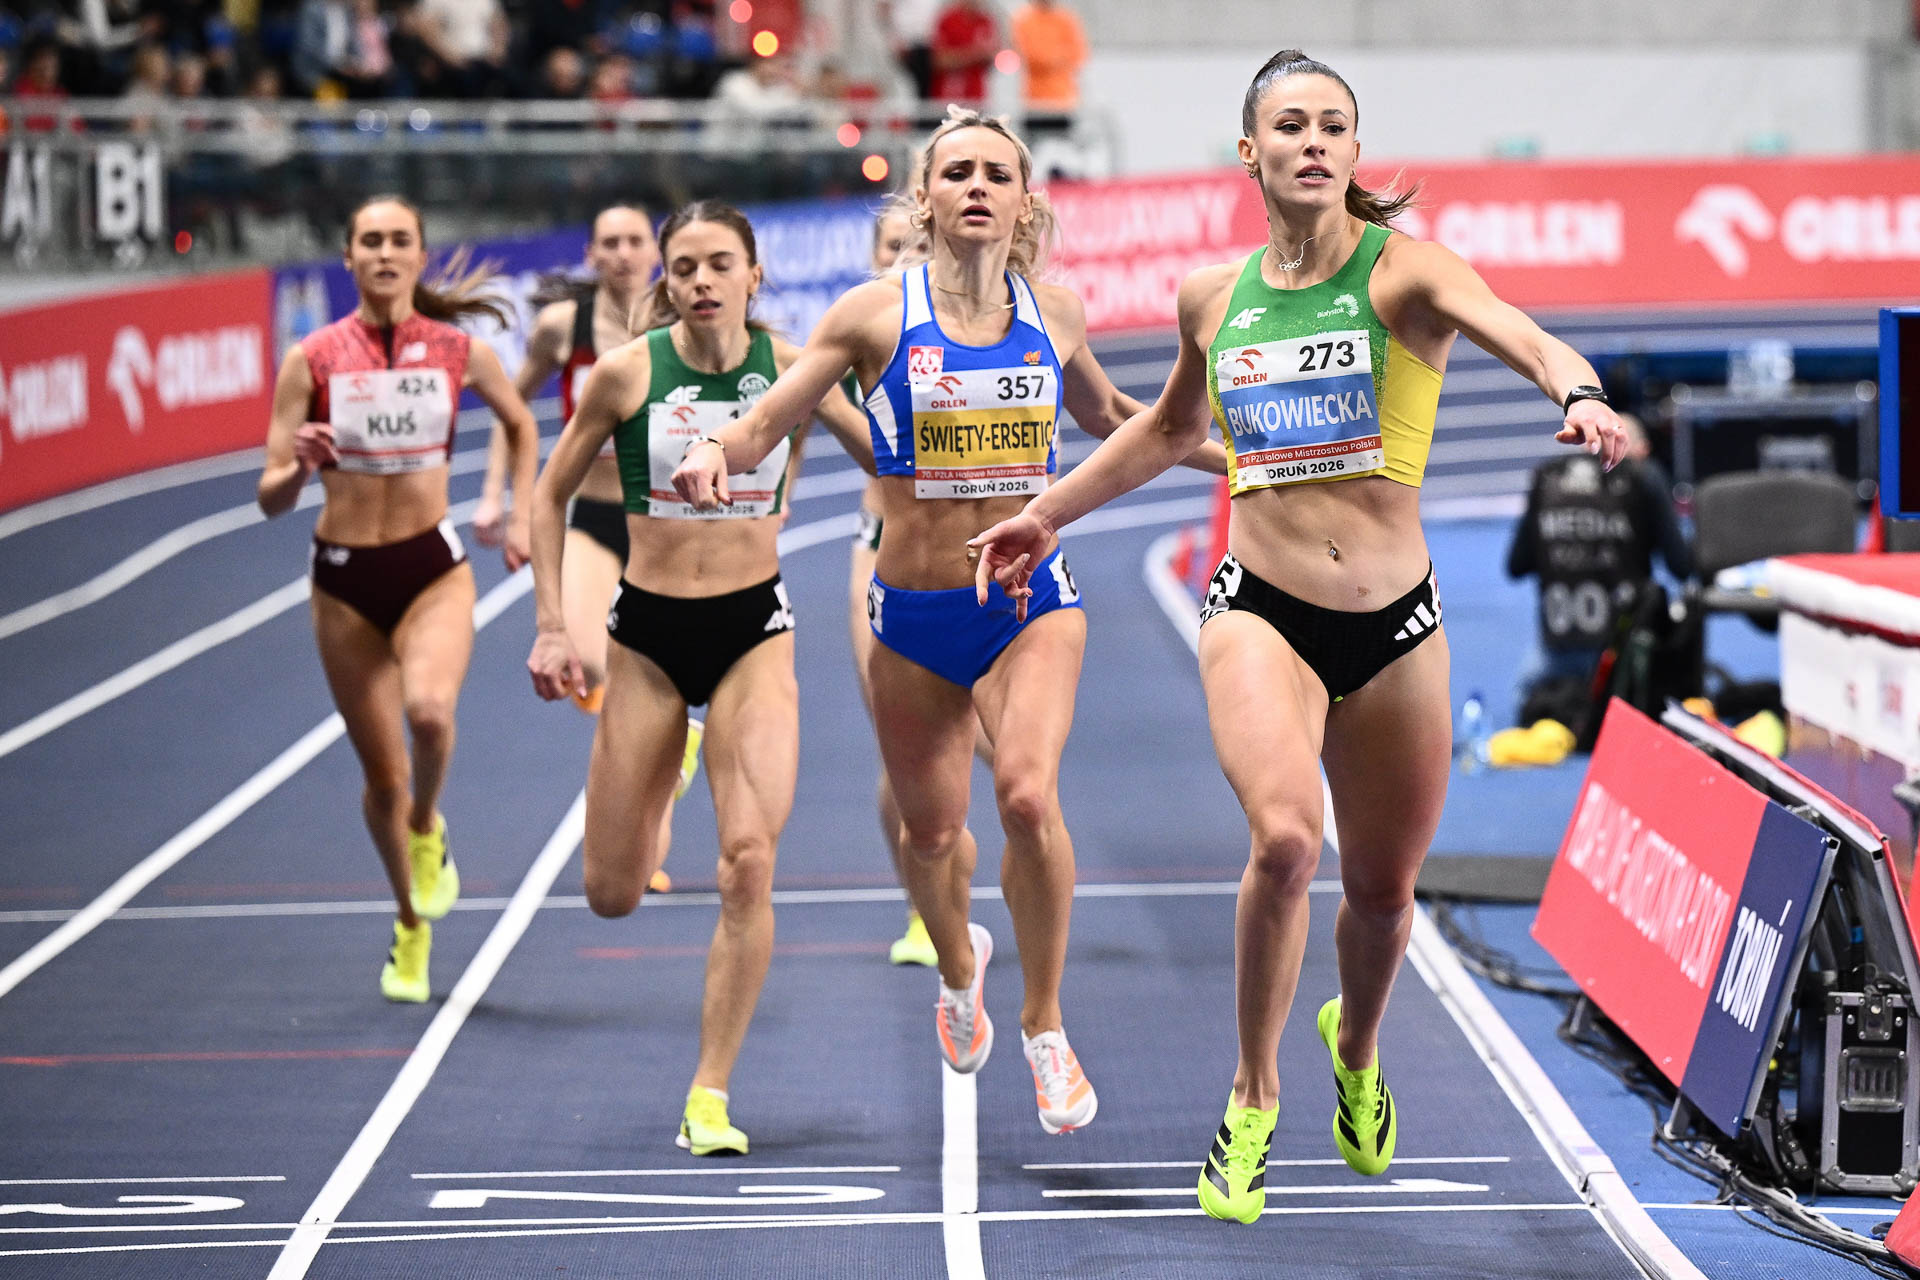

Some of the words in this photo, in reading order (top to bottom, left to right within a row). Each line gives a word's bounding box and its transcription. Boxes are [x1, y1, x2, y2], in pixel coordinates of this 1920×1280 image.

[97, 140, 163, 240] B1
[1434, 202, 1624, 265] ORLEN
[1298, 341, 1355, 372] 273
[157, 325, 263, 411] ORLEN
[398, 376, 437, 396] 424
[997, 375, 1044, 400] 357
[1233, 373, 1267, 386] ORLEN
[664, 385, 702, 402] 4F
[931, 399, 967, 409] ORLEN
[367, 411, 417, 437] KUŚ
[1227, 390, 1373, 437] BUKOWIECKA
[1295, 445, 1348, 459] Mistrzostwa
[1351, 439, 1376, 451] Polski
[955, 469, 985, 479] Halowe
[987, 467, 1034, 477] Mistrzostwa
[1310, 460, 1345, 475] 2026
[952, 481, 996, 494] TORUŃ
[999, 481, 1029, 491] 2026
[1715, 899, 1792, 1033] TORUŃ
